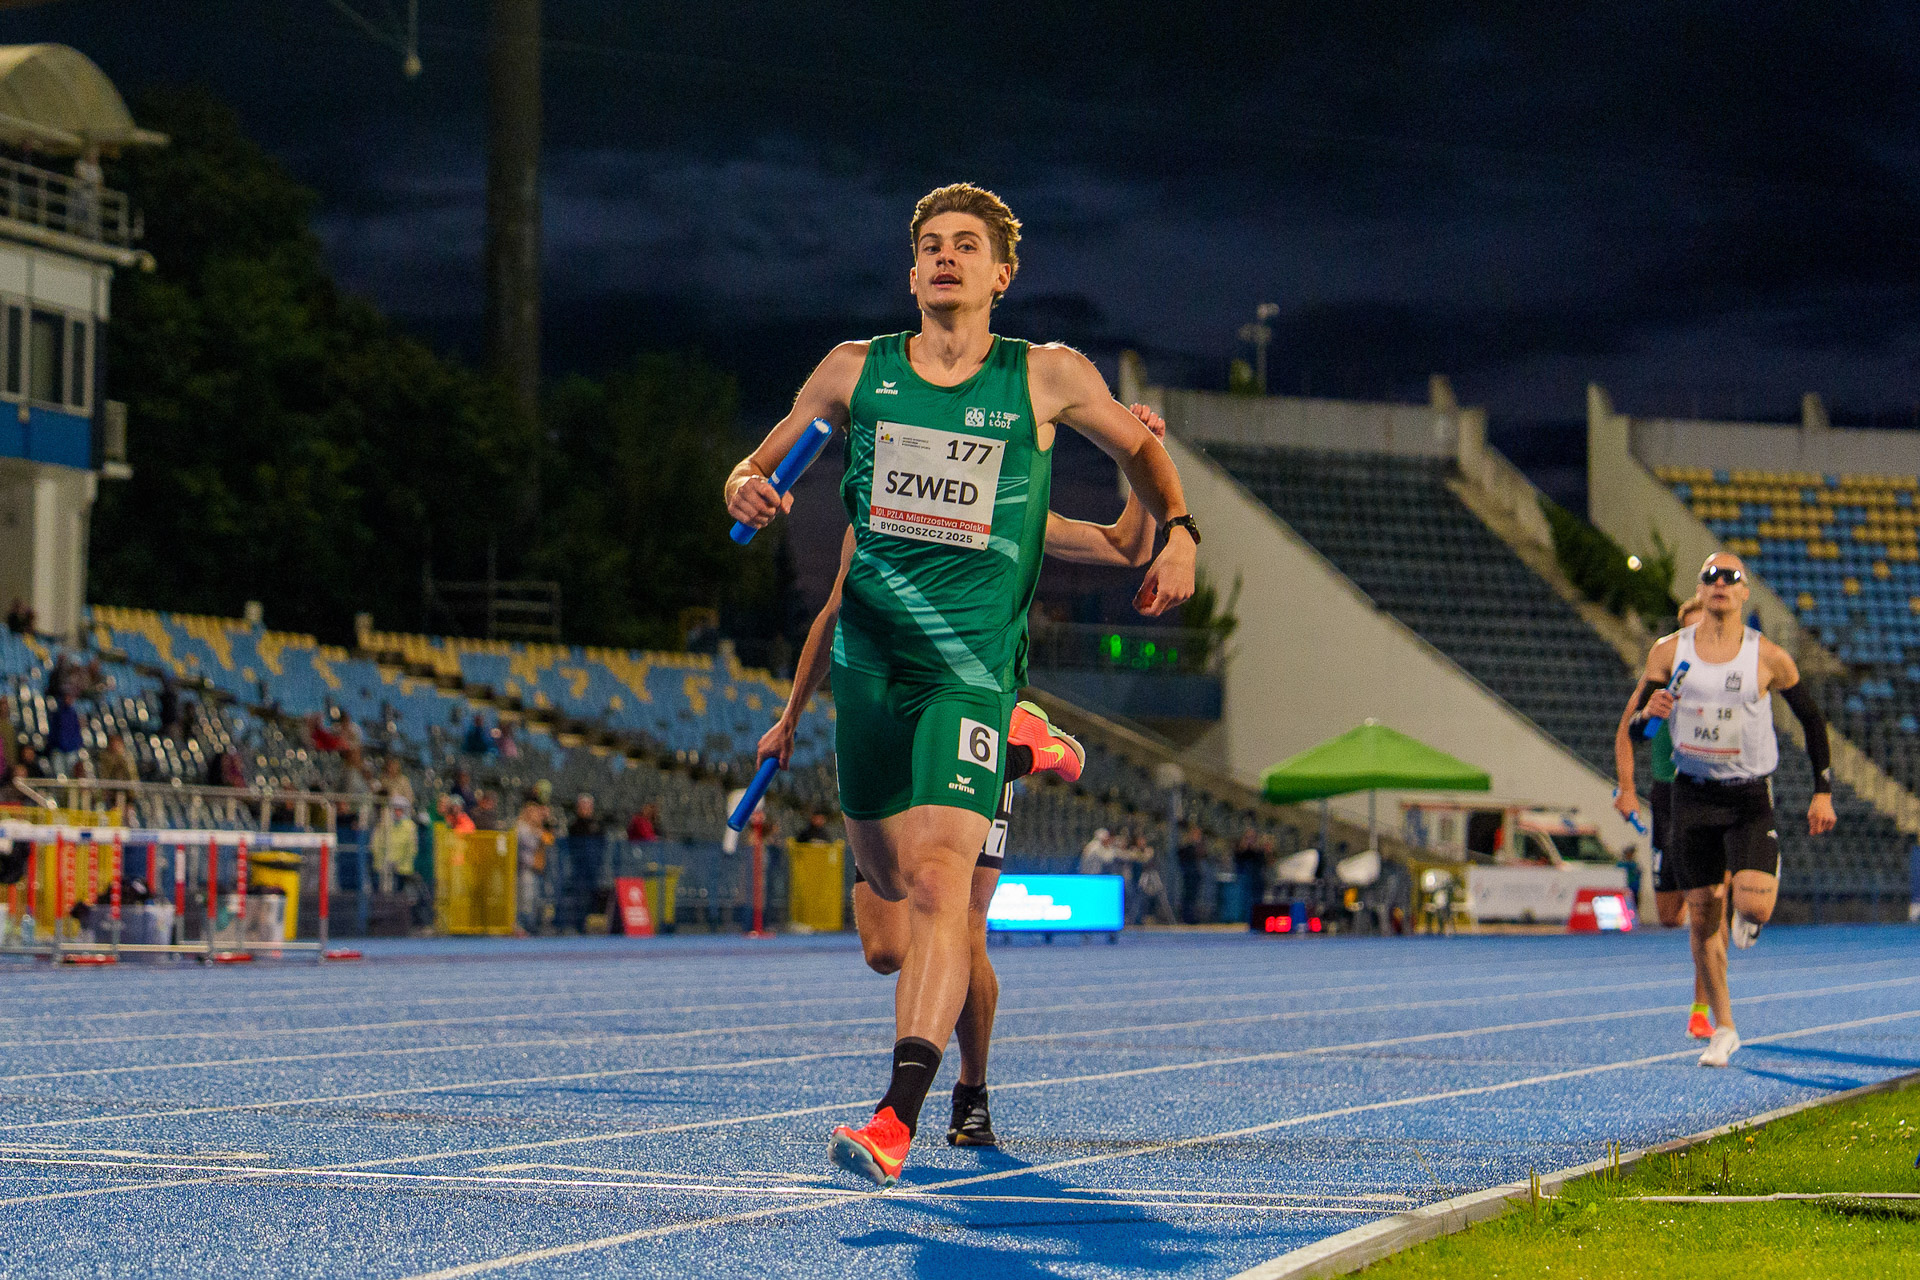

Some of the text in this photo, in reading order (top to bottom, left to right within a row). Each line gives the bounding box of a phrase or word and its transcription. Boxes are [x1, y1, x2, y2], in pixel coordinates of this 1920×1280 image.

[875, 387, 899, 395] erima
[946, 439, 993, 464] 177
[885, 470, 979, 506] SZWED
[880, 521, 974, 544] BYDGOSZCZ 2025
[886, 508, 904, 520] PZLA
[905, 513, 958, 528] Mistrzostwa
[959, 521, 985, 533] Polski
[1717, 707, 1732, 720] 18
[969, 726, 991, 763] 6
[1694, 724, 1720, 741] PAŚ
[948, 781, 975, 795] erima
[995, 823, 1006, 853] 7
